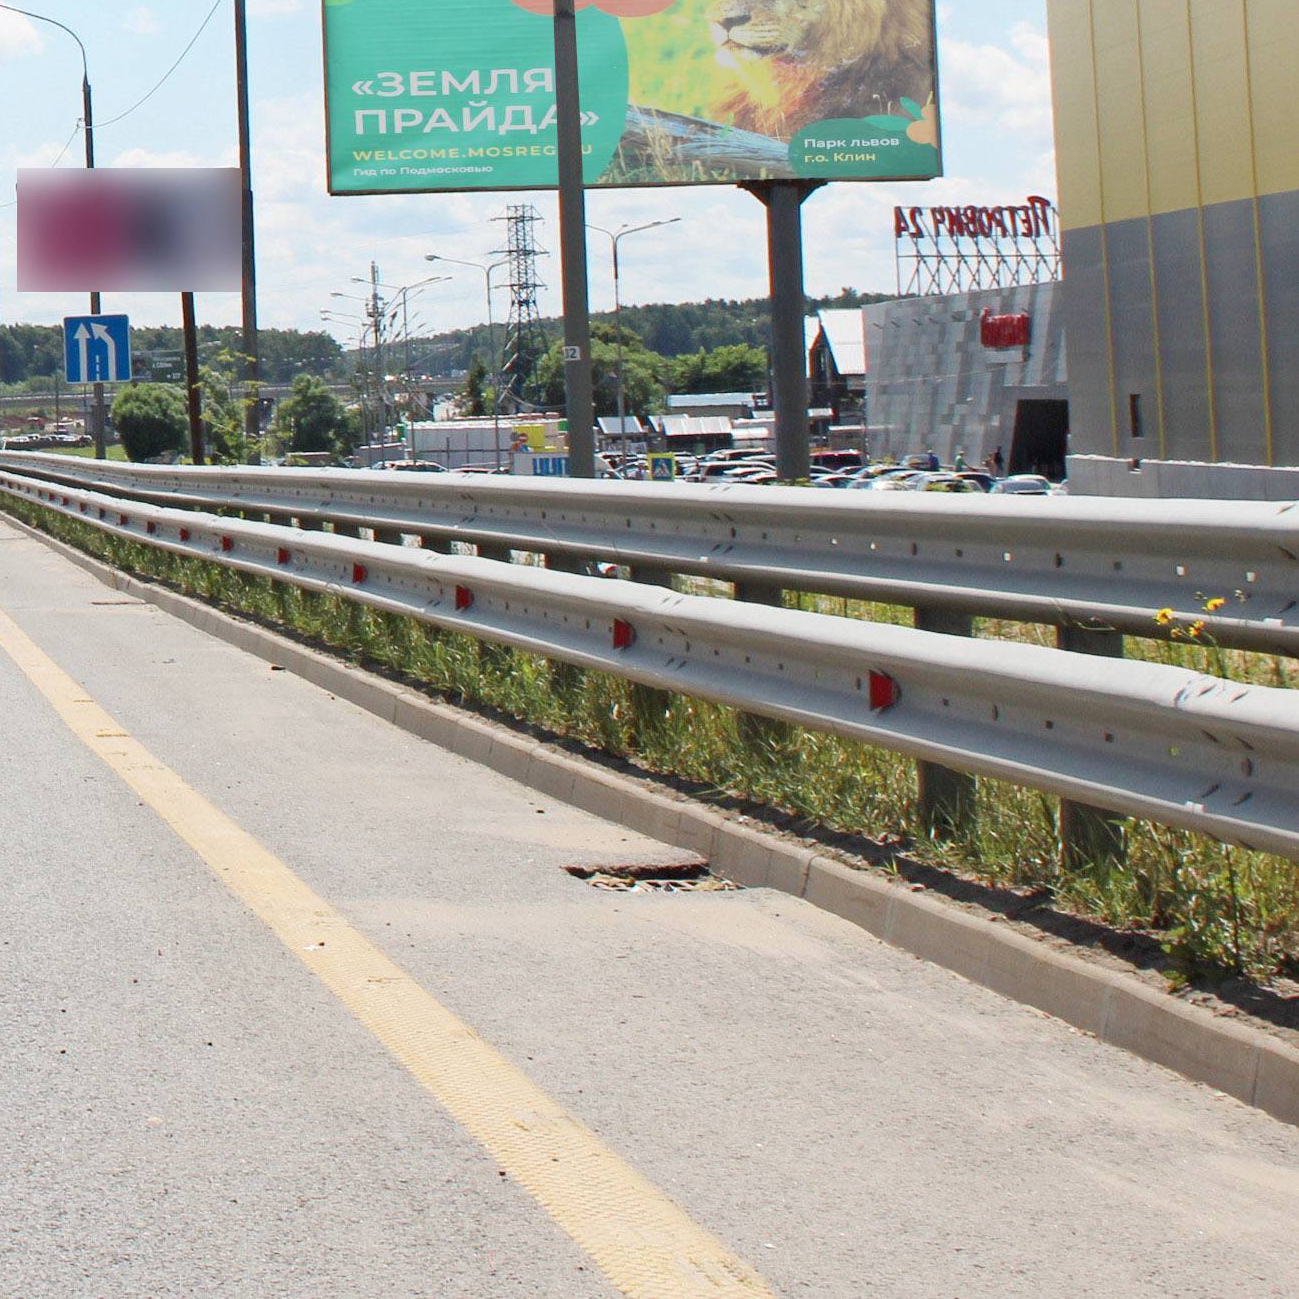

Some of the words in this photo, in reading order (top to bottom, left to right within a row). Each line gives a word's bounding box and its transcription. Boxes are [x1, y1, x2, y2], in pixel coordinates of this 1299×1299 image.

[351, 67, 554, 97] «ЗЕМЛЯ
[804, 139, 847, 150] Парк
[850, 138, 900, 147] львов
[353, 144, 594, 161] WELCOME.MOSREGU
[804, 154, 829, 163] г.о.
[833, 152, 876, 162] Клин
[353, 167, 377, 177] Гид
[380, 168, 397, 176] по
[400, 165, 494, 175] Подмосковью
